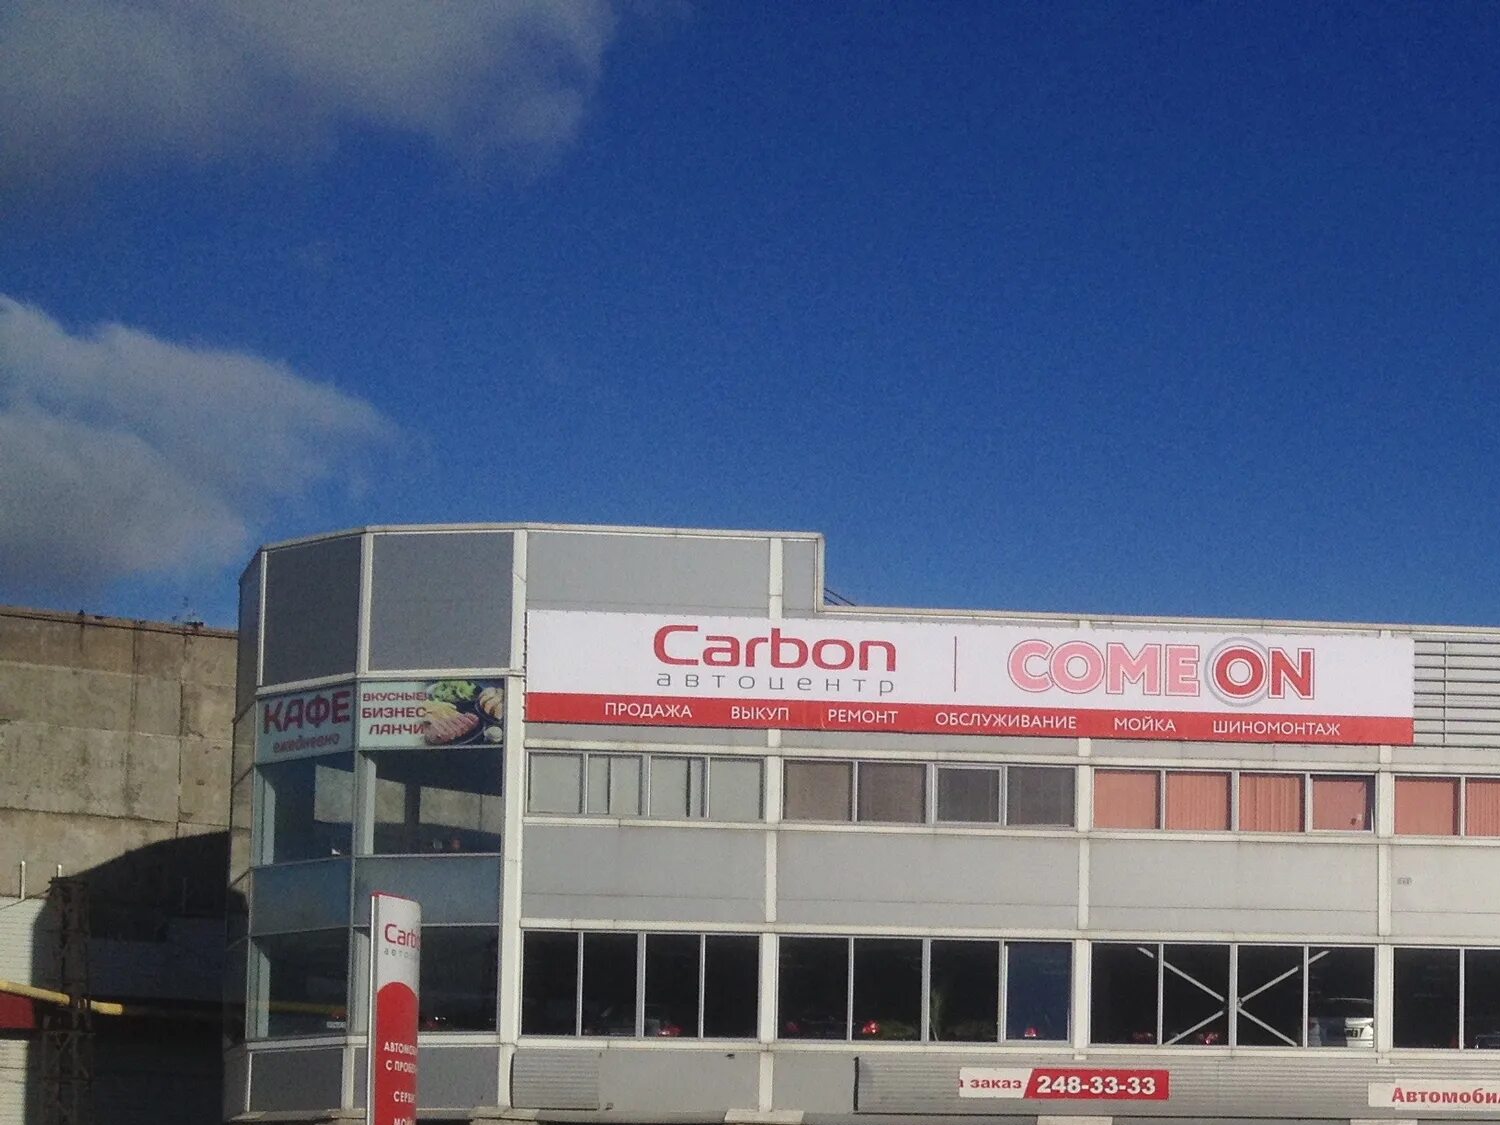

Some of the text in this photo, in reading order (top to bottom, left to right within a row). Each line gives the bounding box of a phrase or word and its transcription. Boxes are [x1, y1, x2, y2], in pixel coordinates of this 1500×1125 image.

[653, 624, 897, 672] Carbon
[656, 672, 895, 697] автоцентр
[263, 691, 351, 735] КАФЕ
[361, 706, 433, 719] БИЗНЕС-
[604, 702, 1342, 737] ПРОДАЖА ВЫКУП РЕМОНТ ОБСЛУЖИВАНИЕ МОЙКА ШИНОМОНТАЖ
[368, 723, 425, 736] ЛАНЧИ
[385, 1059, 393, 1071] С
[969, 1078, 1022, 1090] заказ
[1036, 1075, 1156, 1095] 248-33-33
